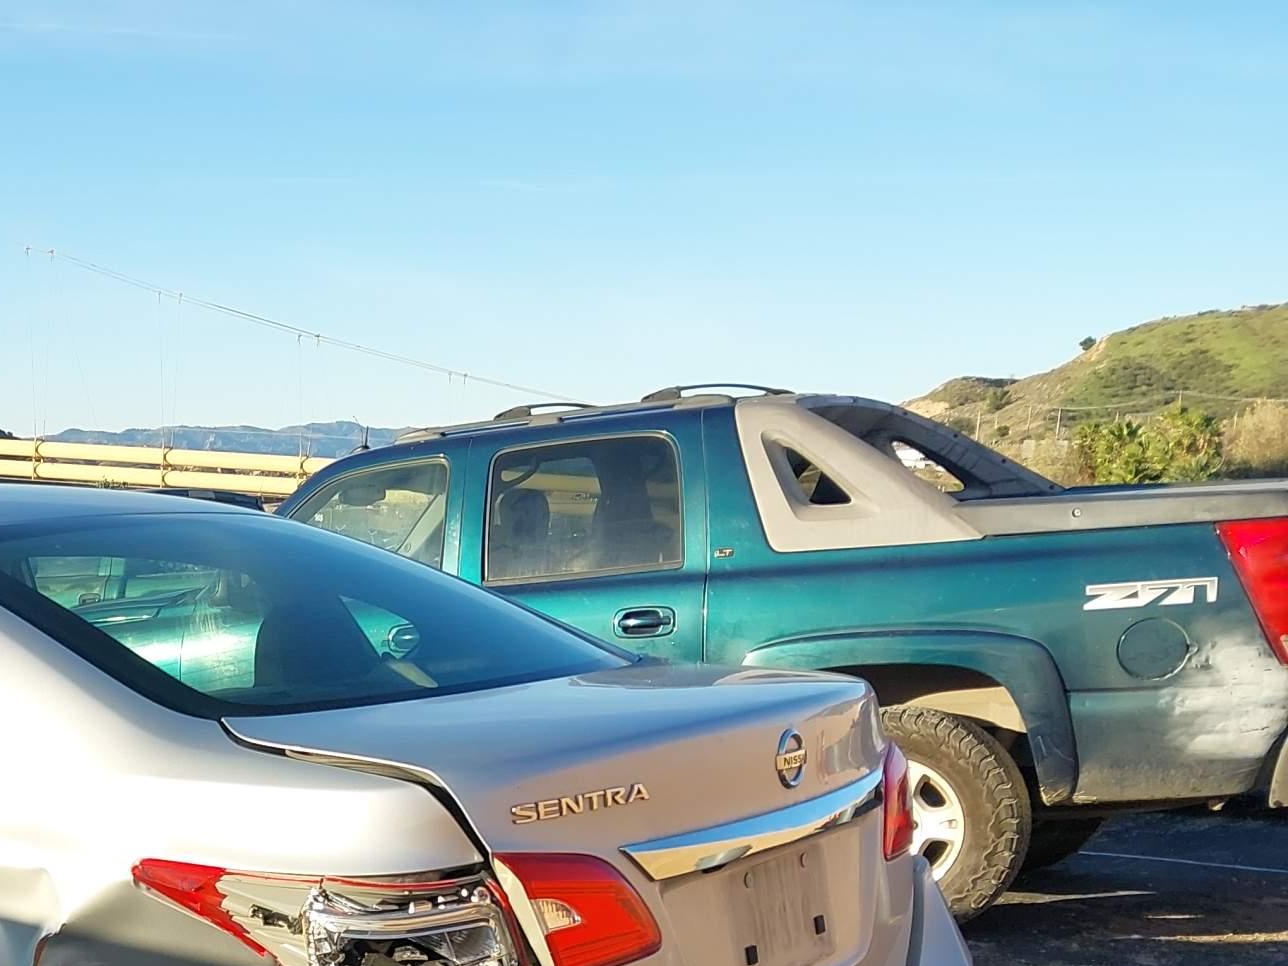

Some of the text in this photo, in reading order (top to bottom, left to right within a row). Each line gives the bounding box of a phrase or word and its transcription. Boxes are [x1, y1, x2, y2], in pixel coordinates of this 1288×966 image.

[1083, 576, 1219, 610] Z71
[783, 753, 806, 767] NISS
[511, 783, 650, 824] SENTRA
